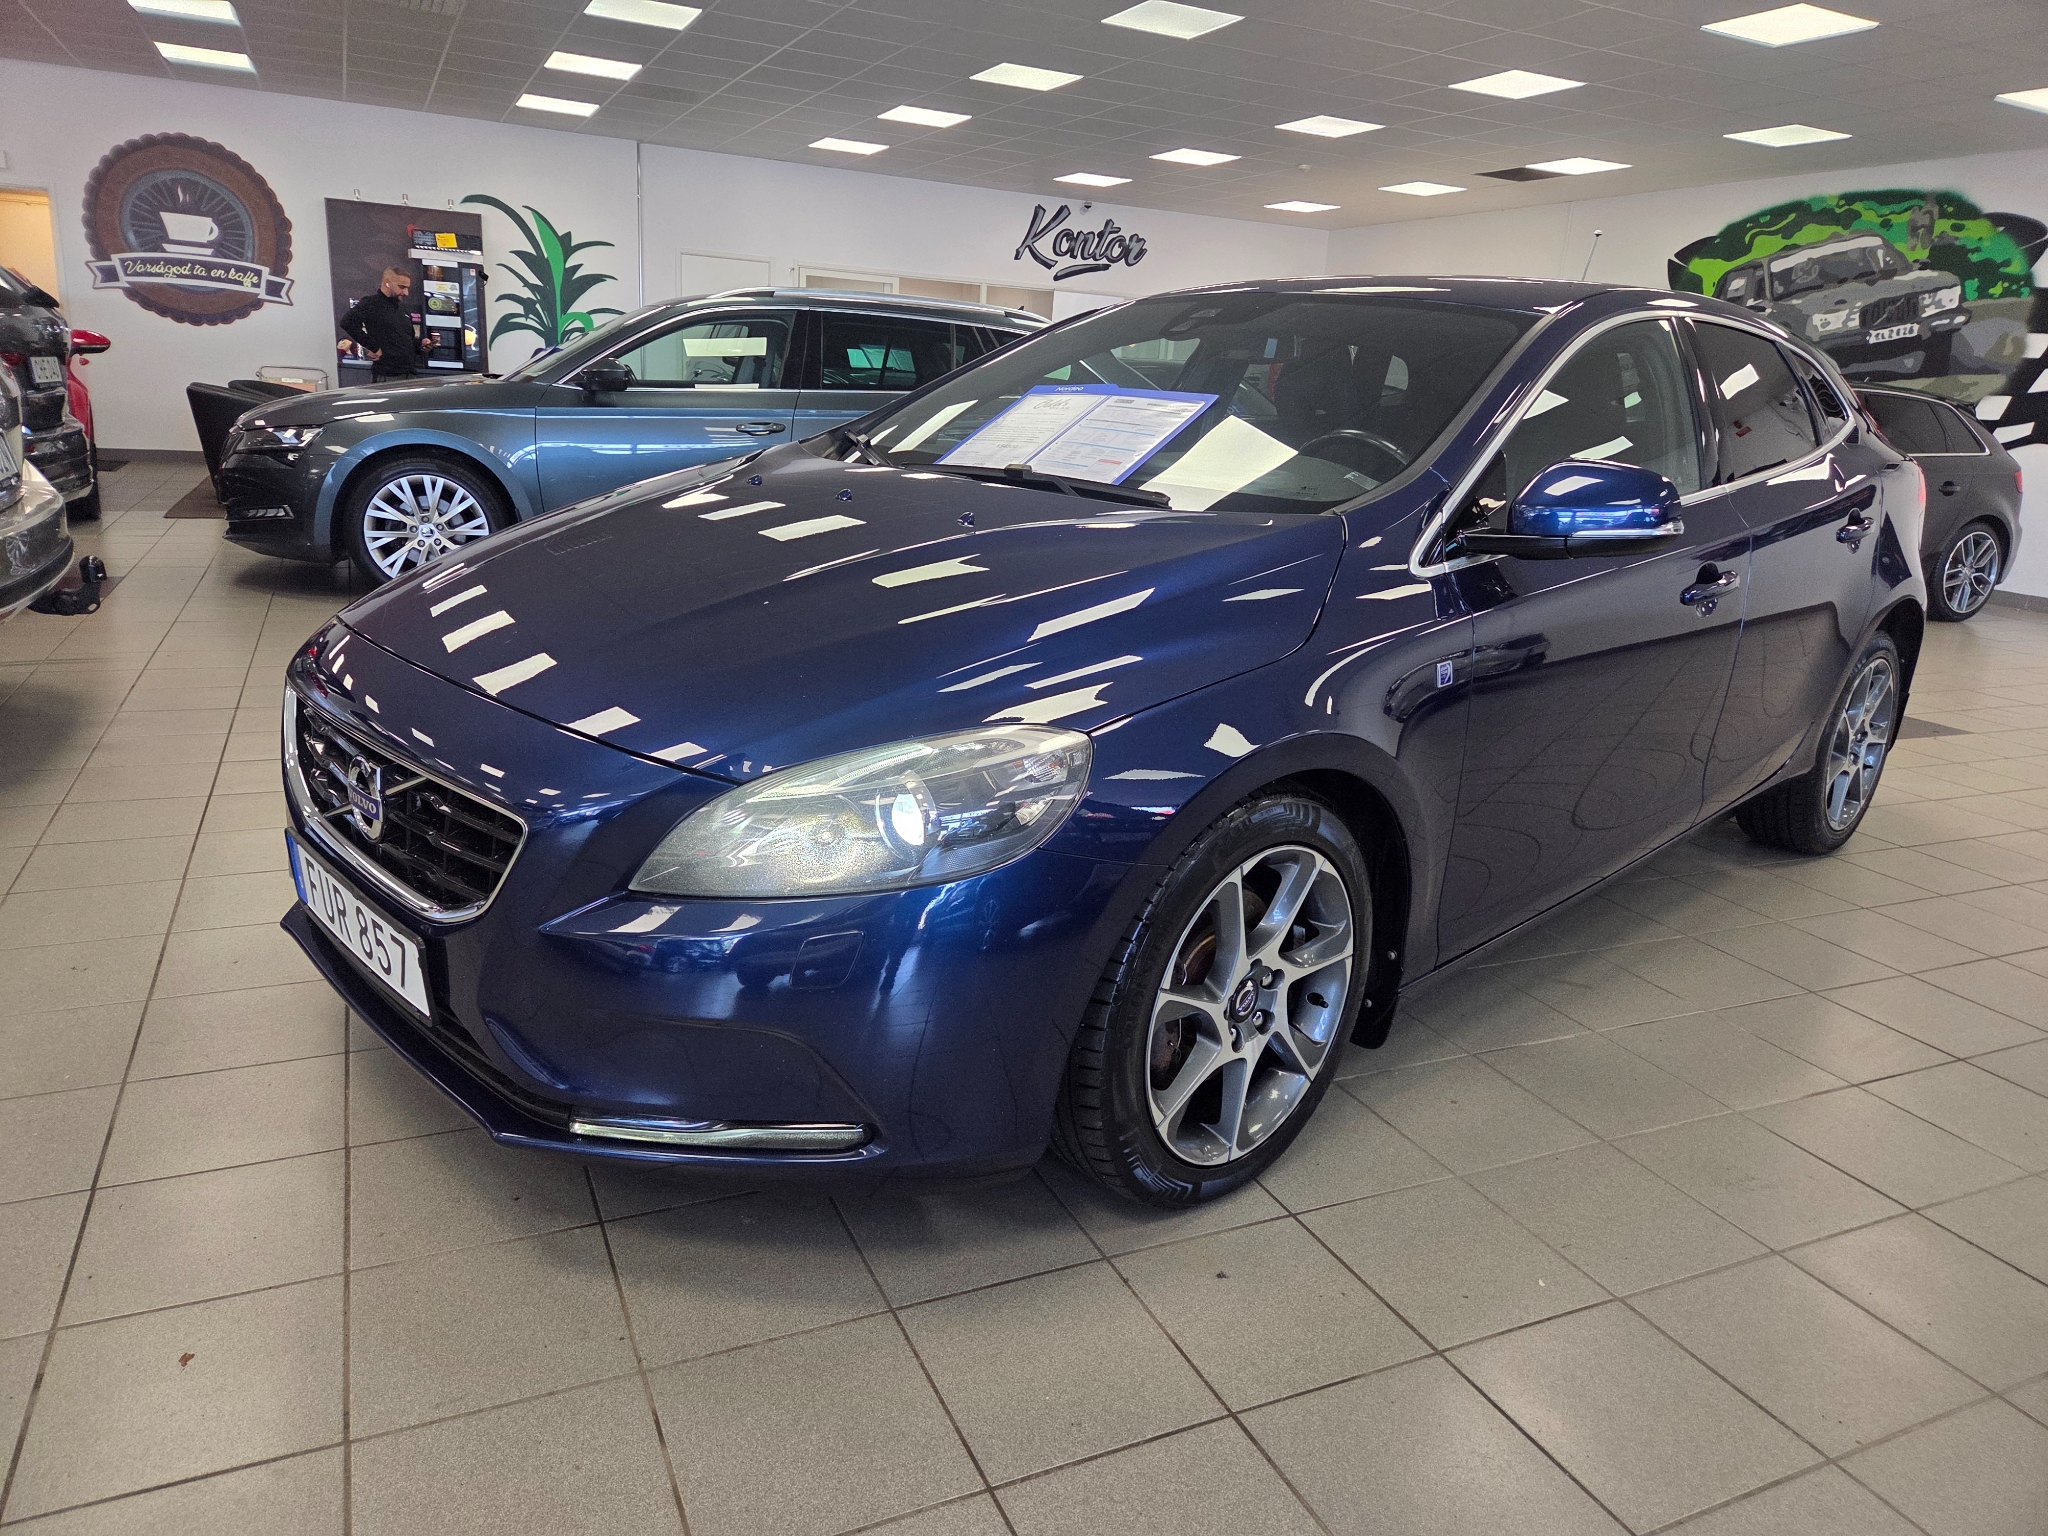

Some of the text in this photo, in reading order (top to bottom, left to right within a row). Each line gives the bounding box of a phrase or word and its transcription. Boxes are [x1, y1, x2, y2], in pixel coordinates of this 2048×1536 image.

[1014, 204, 1148, 269] Kontor
[124, 260, 259, 287] Varsågod ta en kaffe
[350, 789, 377, 814] VOLVO
[305, 856, 406, 990] FUR 857
